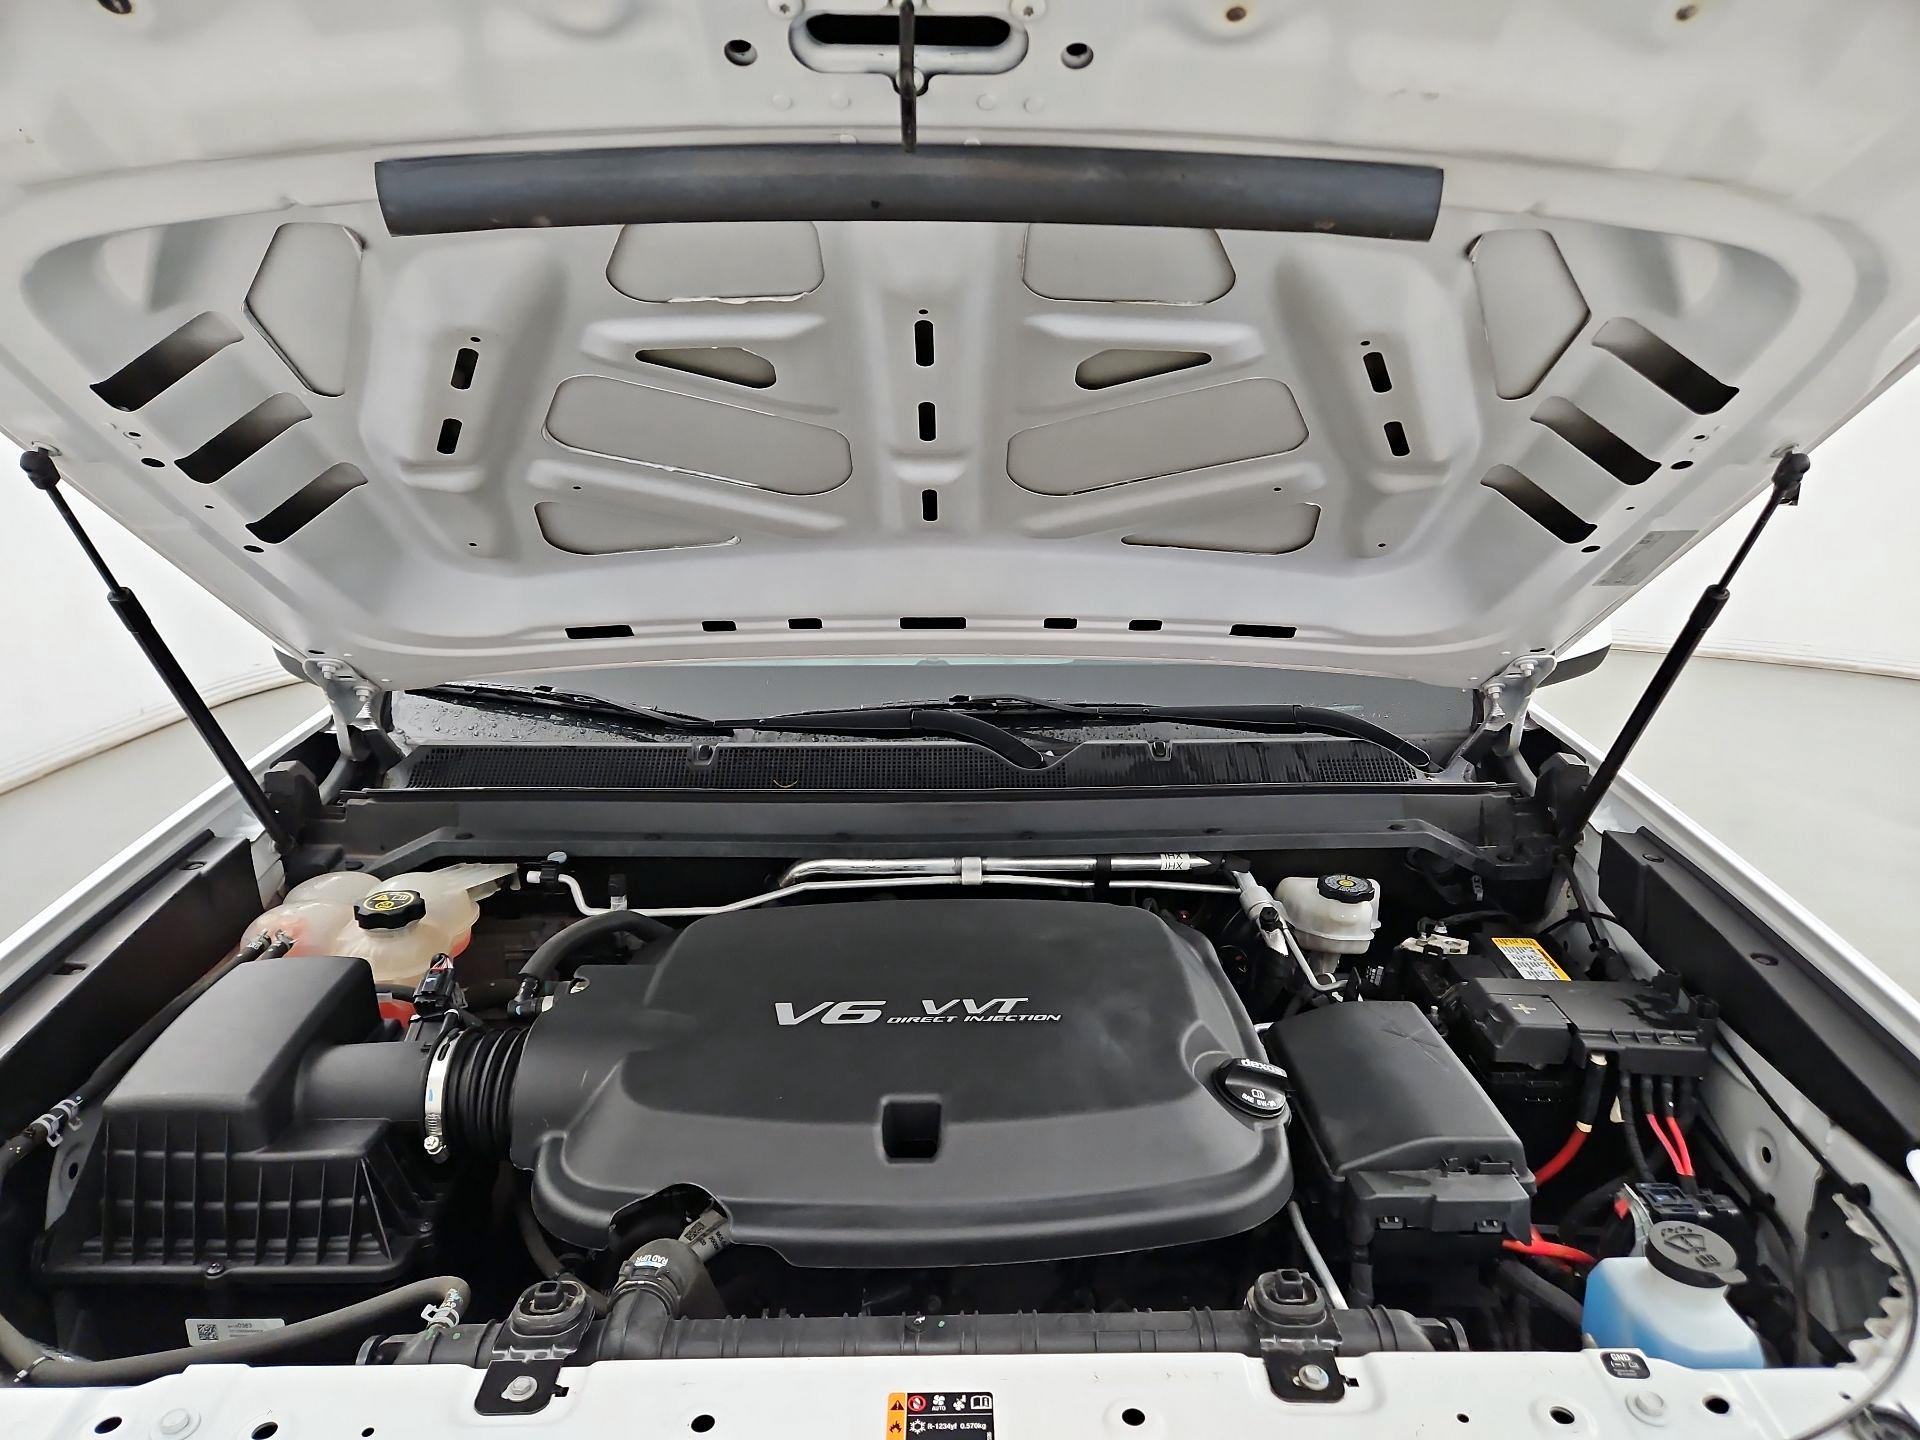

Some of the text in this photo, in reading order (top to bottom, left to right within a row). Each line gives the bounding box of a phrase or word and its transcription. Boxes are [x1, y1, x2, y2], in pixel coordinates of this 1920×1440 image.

[775, 997, 1029, 1026] V6 VVT
[886, 1014, 1062, 1024] DIRECT INJECTION
[1610, 1353, 1631, 1361] GND
[927, 1422, 957, 1430] R-1234yf
